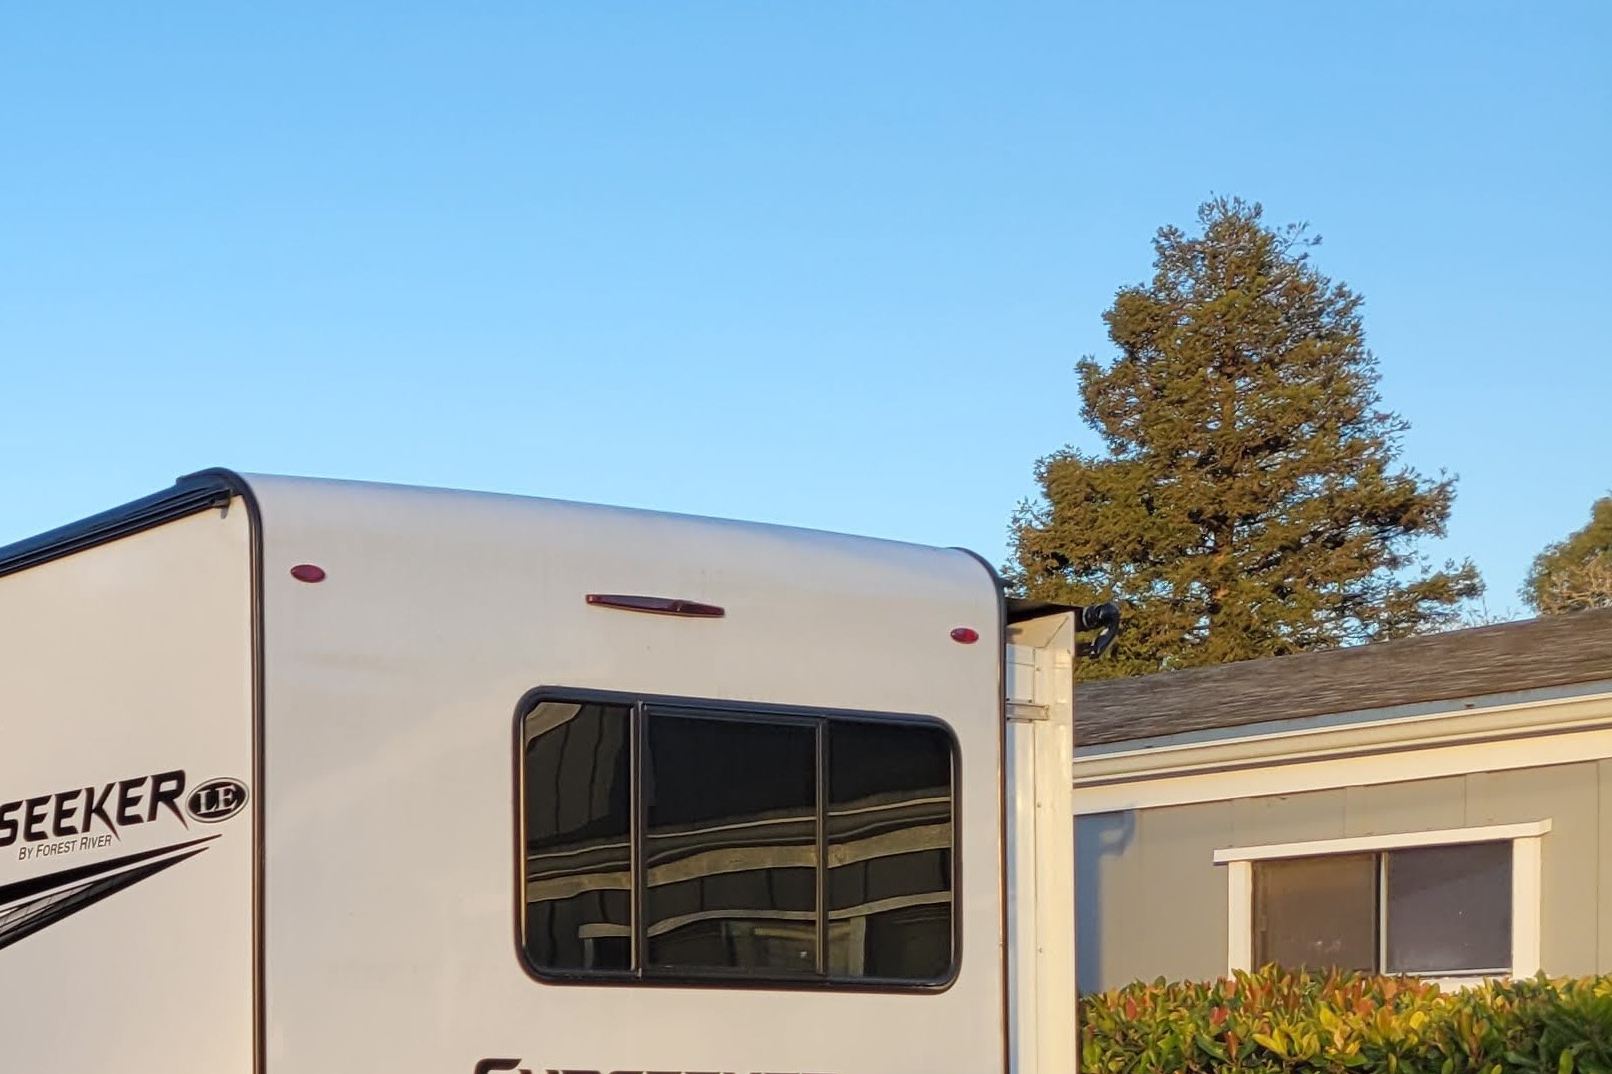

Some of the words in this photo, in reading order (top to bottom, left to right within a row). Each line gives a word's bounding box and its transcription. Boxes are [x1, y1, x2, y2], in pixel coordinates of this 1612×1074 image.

[196, 784, 237, 815] LE
[18, 846, 33, 861] BY
[36, 840, 78, 858] FOREST
[79, 834, 112, 852] RIVER
